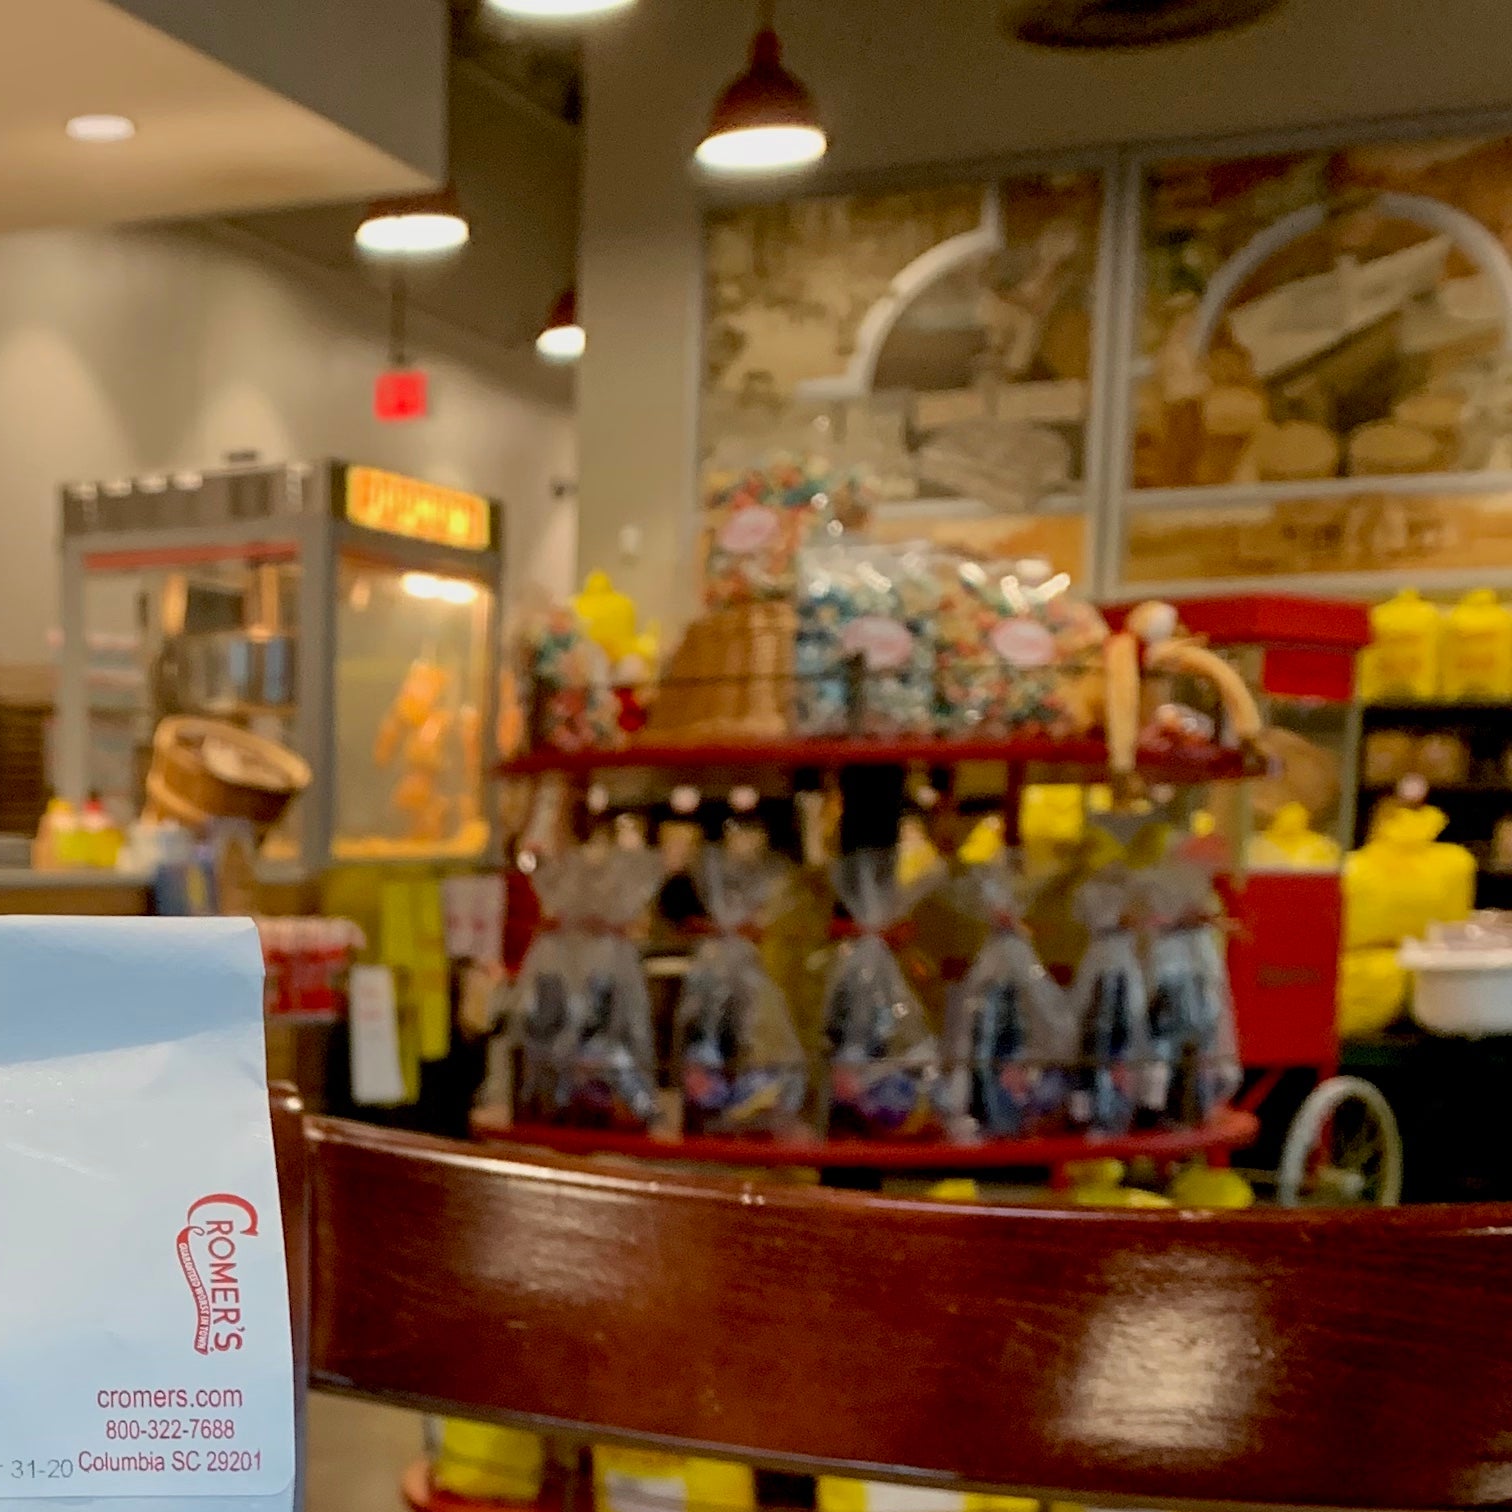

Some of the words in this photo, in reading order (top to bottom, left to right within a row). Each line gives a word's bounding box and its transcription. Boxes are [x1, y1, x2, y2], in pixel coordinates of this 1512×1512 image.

[181, 1193, 259, 1353] CROMER'S
[196, 1326, 209, 1350] TOWN
[97, 1388, 244, 1409] cromers.com
[105, 1418, 236, 1440] 800-322-7688
[10, 1458, 74, 1479] 31-20
[78, 1450, 165, 1473] Columbia
[171, 1450, 201, 1472] SC
[206, 1450, 262, 1472] 29201
